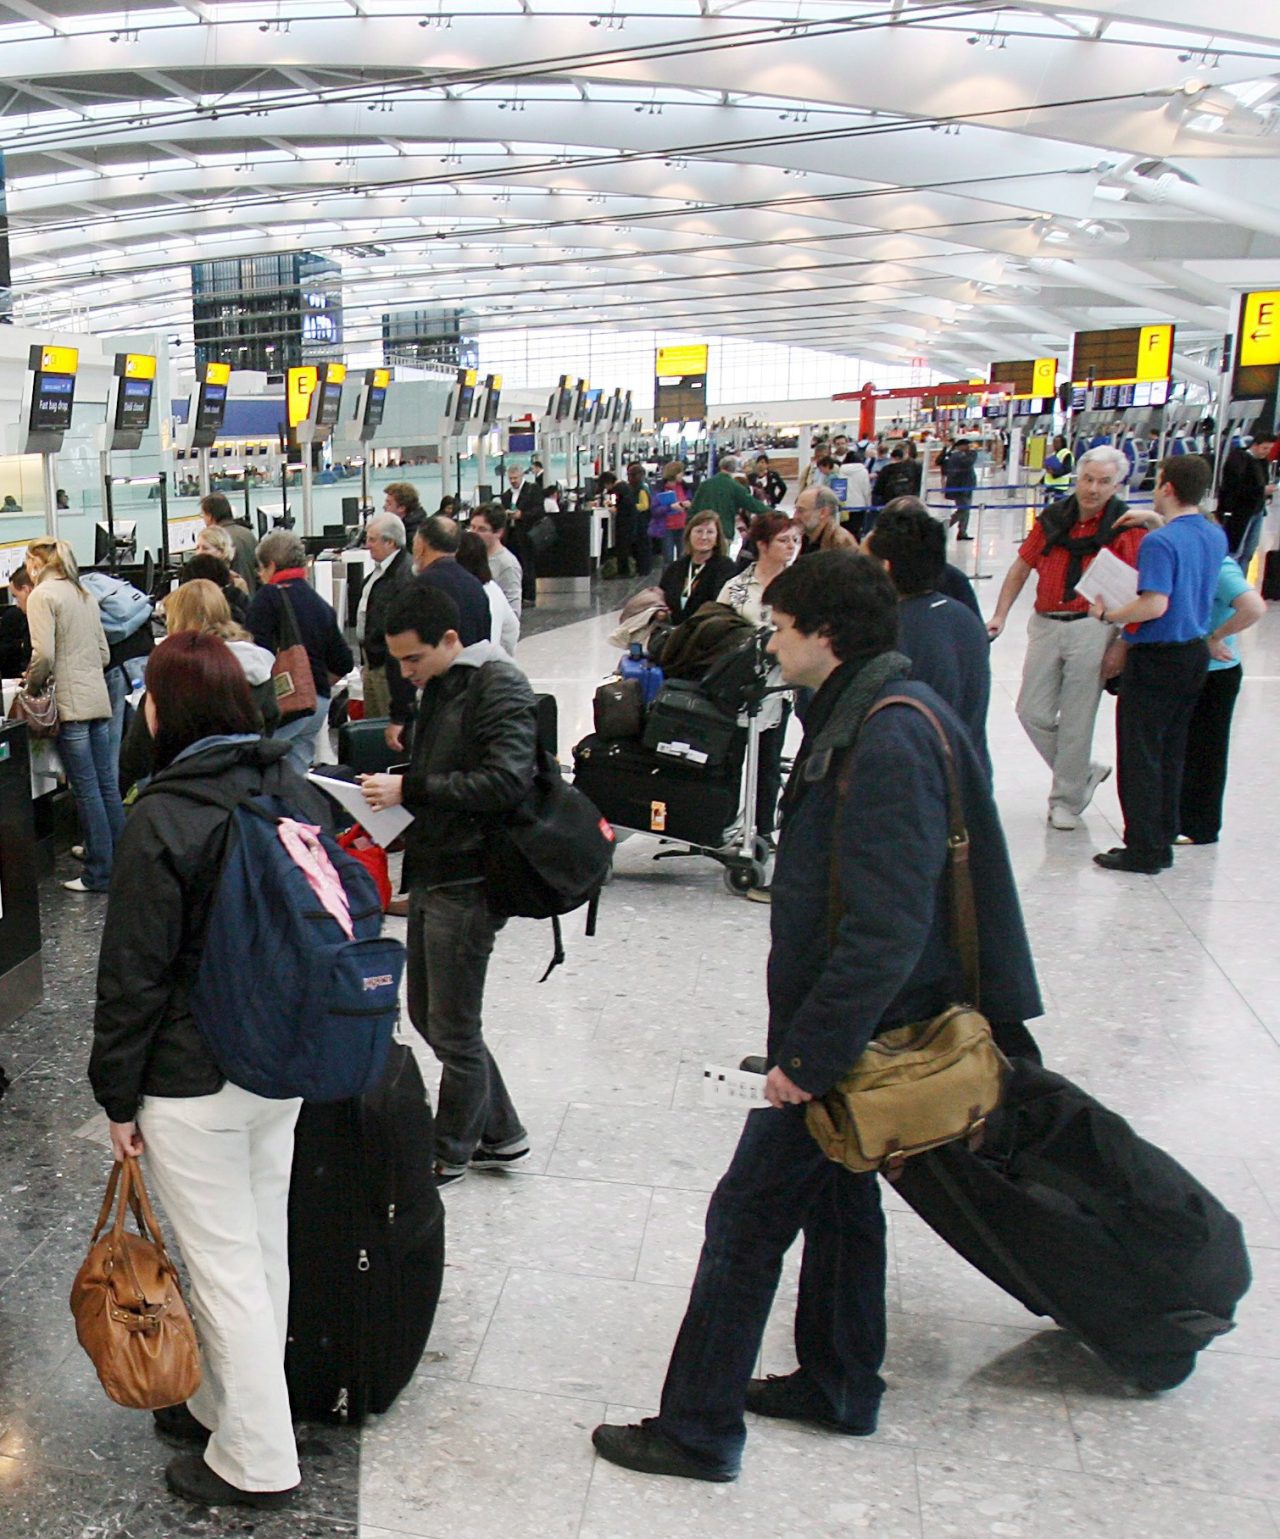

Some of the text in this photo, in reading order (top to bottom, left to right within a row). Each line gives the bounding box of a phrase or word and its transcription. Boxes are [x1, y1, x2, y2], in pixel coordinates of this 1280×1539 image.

[1258, 303, 1274, 325] E
[1148, 334, 1160, 351] F
[1038, 364, 1051, 377] G
[298, 376, 308, 394] E
